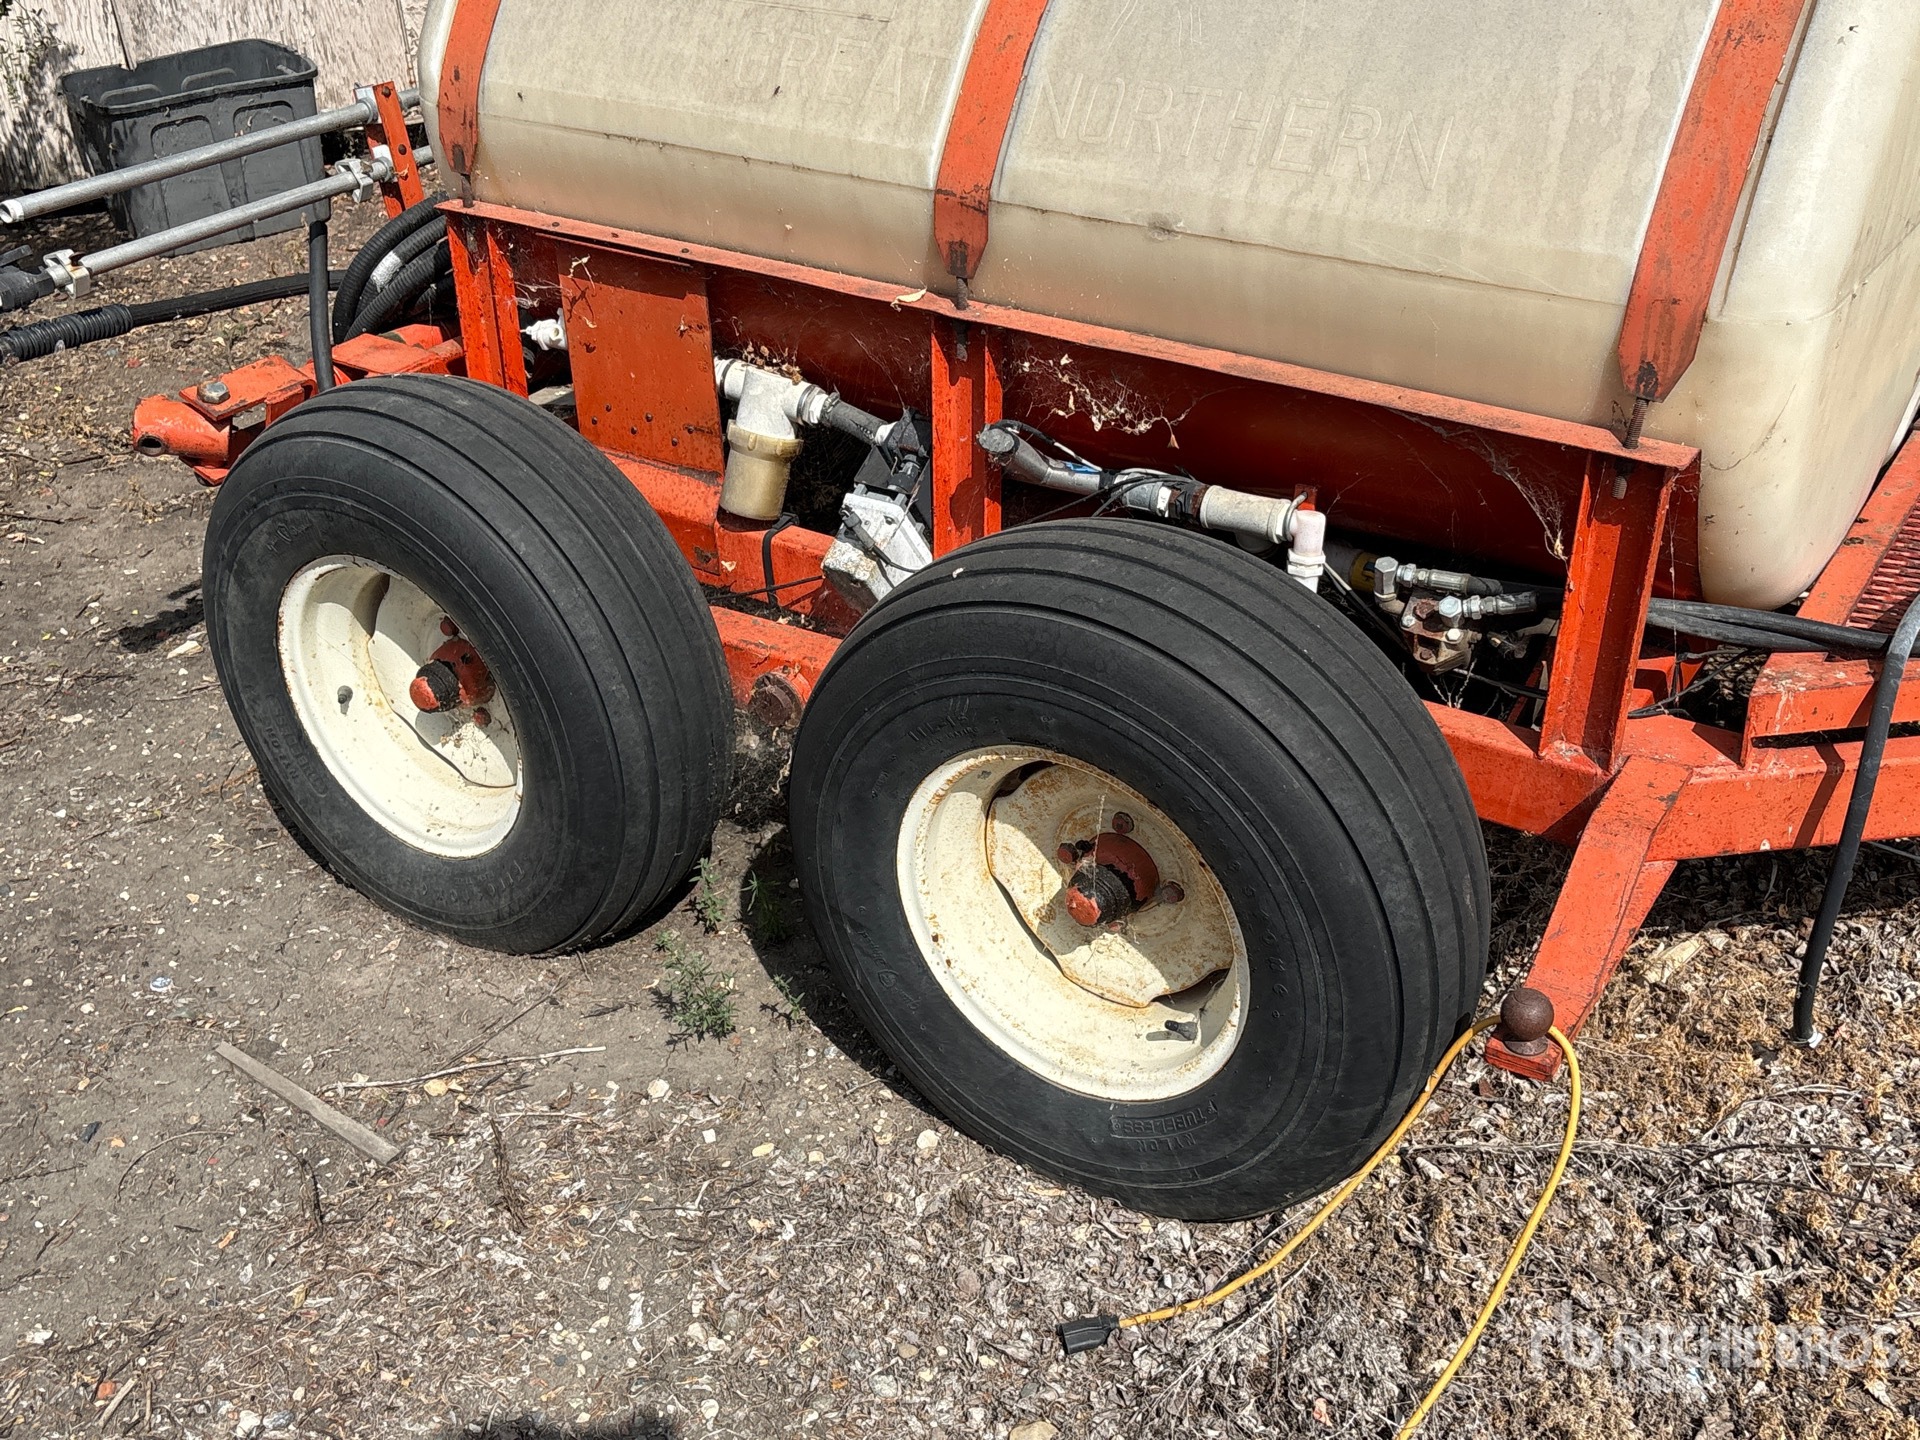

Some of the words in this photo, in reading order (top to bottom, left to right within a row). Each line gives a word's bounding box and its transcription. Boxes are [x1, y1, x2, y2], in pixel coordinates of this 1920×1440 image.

[731, 30, 953, 114] GREAT
[1024, 72, 1455, 191] NORTHERN
[1122, 1107, 1207, 1134] TUBELESS
[1136, 1132, 1197, 1152] NYLON
